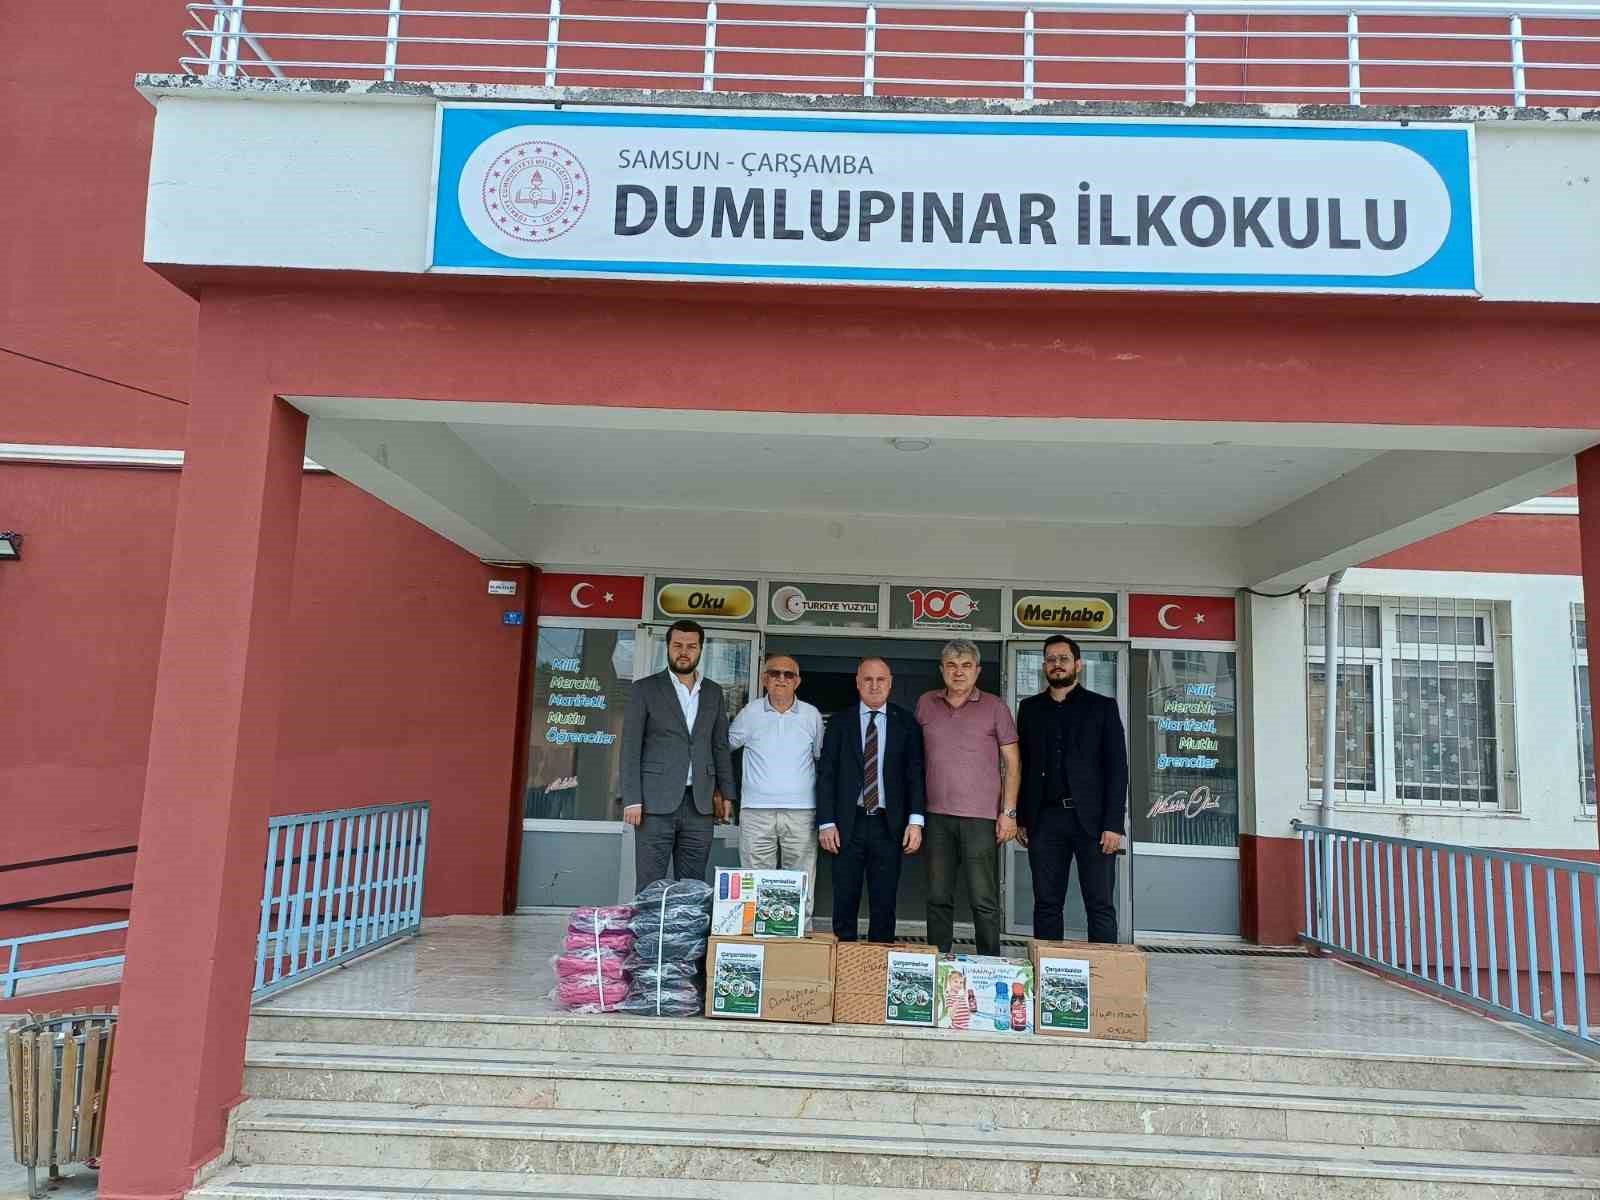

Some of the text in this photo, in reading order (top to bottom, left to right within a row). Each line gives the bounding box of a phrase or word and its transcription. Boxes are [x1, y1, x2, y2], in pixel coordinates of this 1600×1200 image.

[618, 149, 719, 170] SAMSUN
[741, 152, 874, 177] ÇARŞAMBA
[614, 180, 1408, 250] DUMLUPINAR İLKOKULU
[687, 592, 725, 609] Oku
[1023, 604, 1105, 623] Merhaba
[545, 727, 617, 745] Öğrenciler
